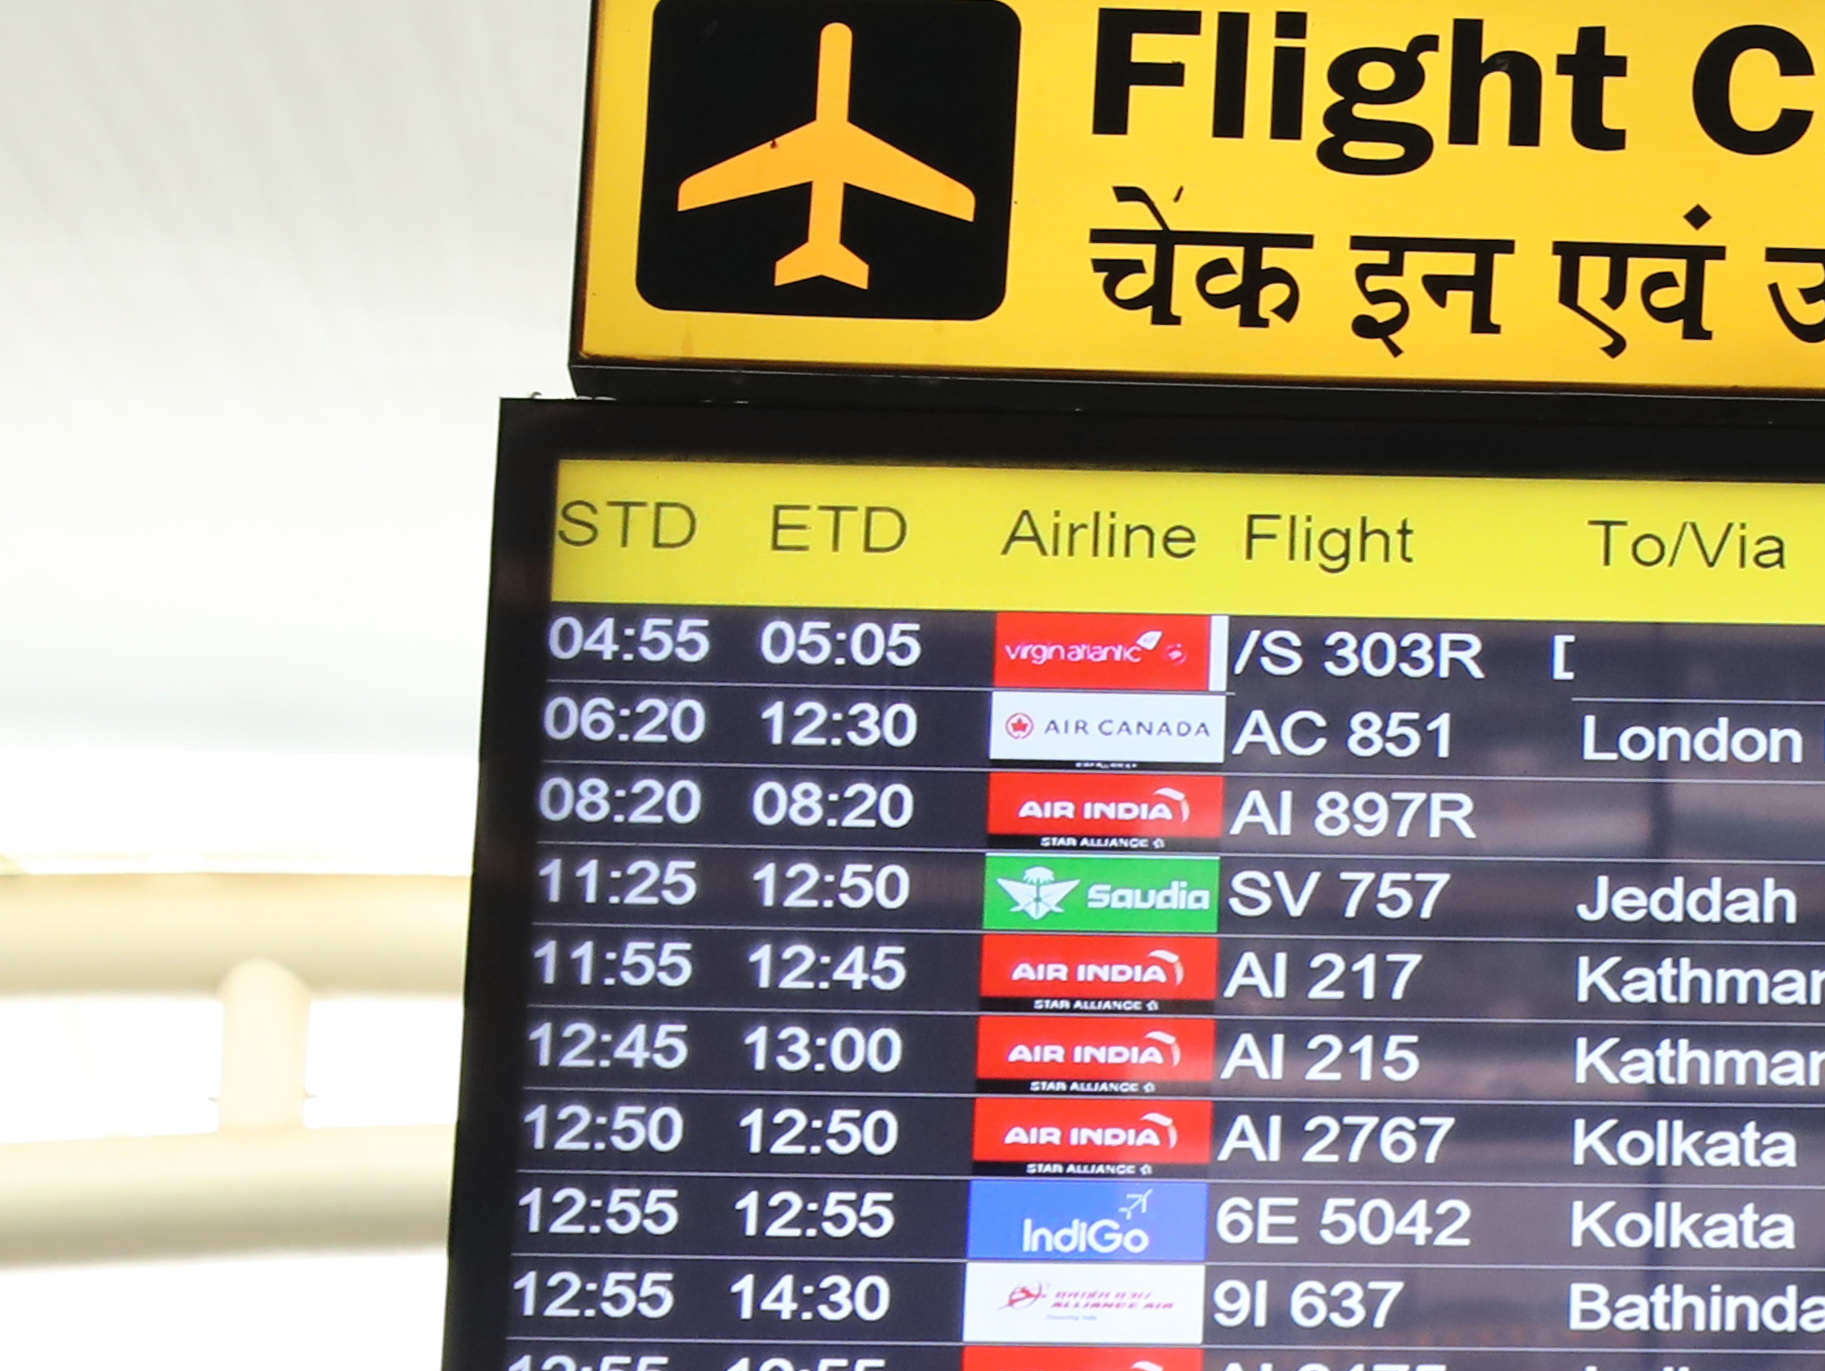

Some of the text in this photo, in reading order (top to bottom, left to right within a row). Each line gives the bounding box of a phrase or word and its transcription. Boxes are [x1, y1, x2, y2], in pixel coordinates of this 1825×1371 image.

[1093, 8, 1627, 176] Flight
[1350, 236, 1515, 358] इन
[1552, 204, 1726, 358] एवं
[556, 500, 700, 553] STD
[771, 505, 906, 553] ETD
[1001, 510, 1195, 558] Airline
[1246, 514, 1413, 573] Flight
[1588, 520, 1785, 569] To/Via
[545, 697, 705, 742] 06:20
[762, 701, 917, 746] 12:30
[1232, 710, 1312, 755] AC
[1348, 710, 1454, 758] 851
[1582, 712, 1802, 765] London
[1045, 720, 1210, 737] AIR CANADA
[1019, 801, 1173, 820] AIR INDIA
[1041, 837, 1149, 848] STAR ALLIANCE
[540, 859, 696, 905] 11:25
[753, 863, 909, 908] 12:50
[1229, 871, 1311, 916] SV
[1340, 872, 1450, 918] 757
[1577, 876, 1796, 923] Jeddah
[1088, 881, 1210, 909] Saudia
[519, 1188, 678, 1234] 12:55
[735, 1191, 894, 1237] 12:55
[1217, 1197, 1298, 1244] 6E
[1320, 1198, 1471, 1245] 5042
[1572, 1201, 1795, 1250] Kolkata
[1023, 1214, 1150, 1253] IndiGo
